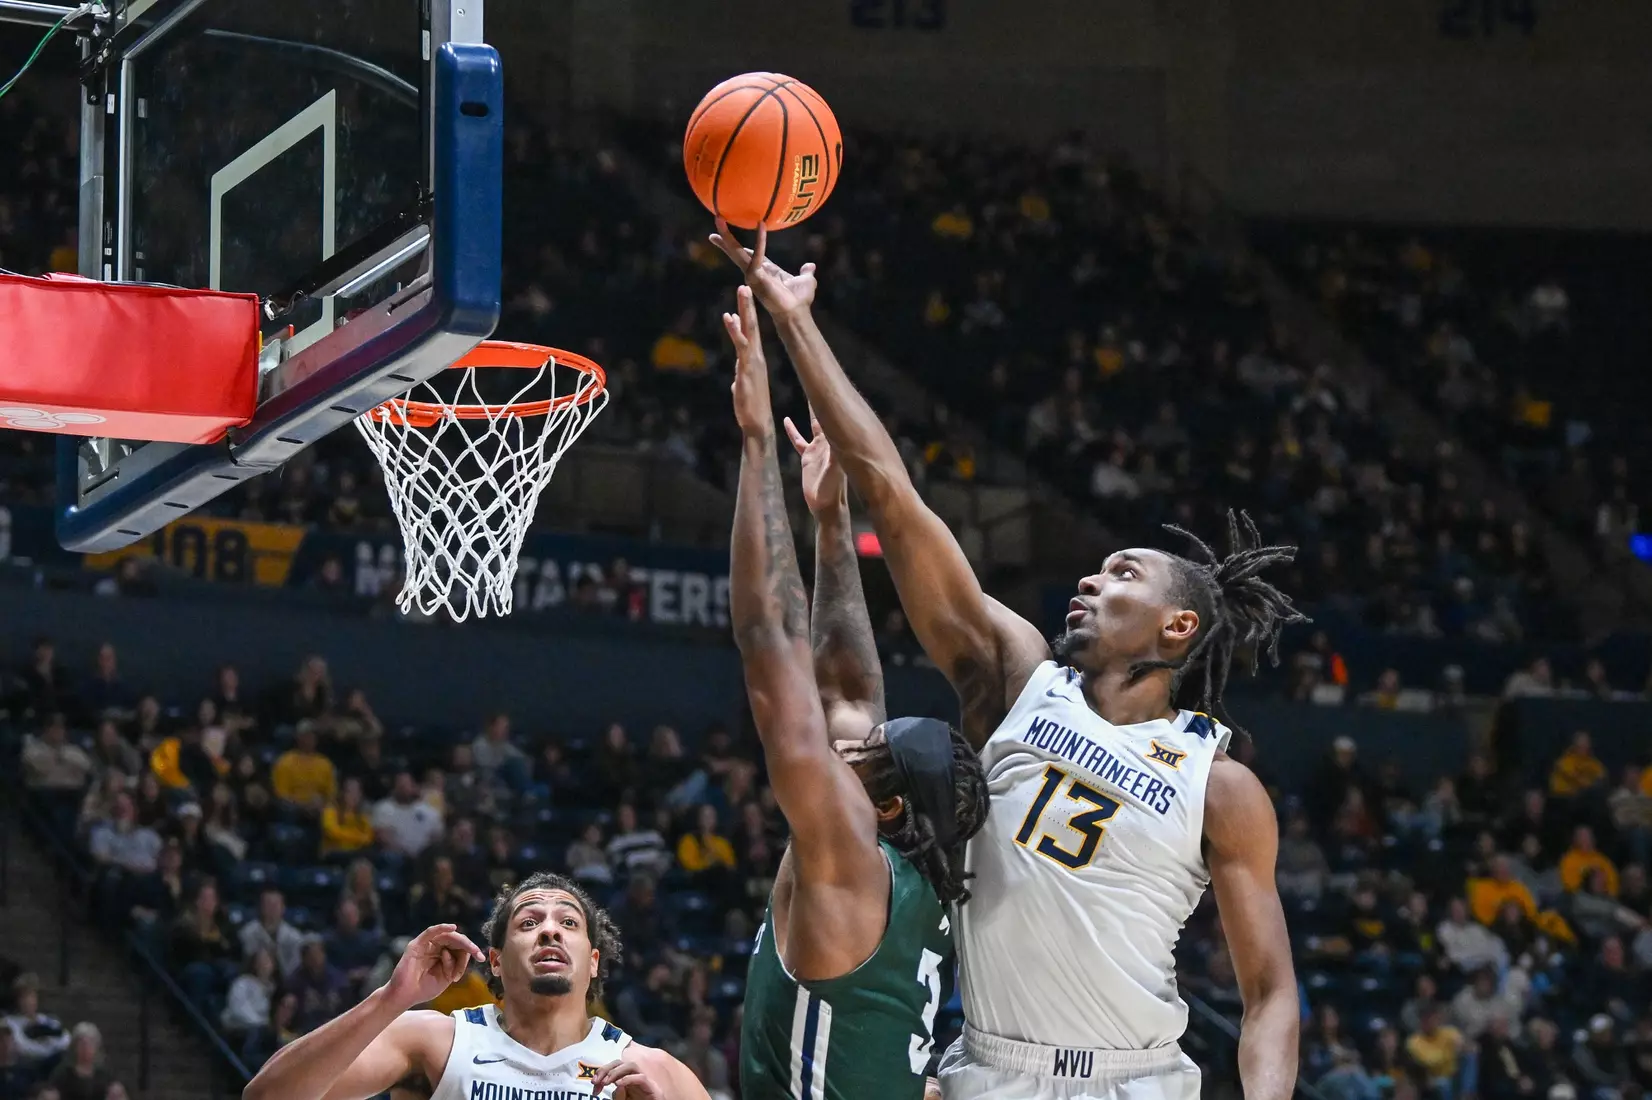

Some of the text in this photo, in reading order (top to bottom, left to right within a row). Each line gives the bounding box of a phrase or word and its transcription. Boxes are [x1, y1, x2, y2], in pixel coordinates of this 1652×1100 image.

[784, 154, 819, 222] ELITE
[1022, 715, 1177, 815] MOUNTAINEERS
[1145, 740, 1187, 770] XII
[1014, 765, 1121, 870] 13
[1053, 1048, 1094, 1078] WVU
